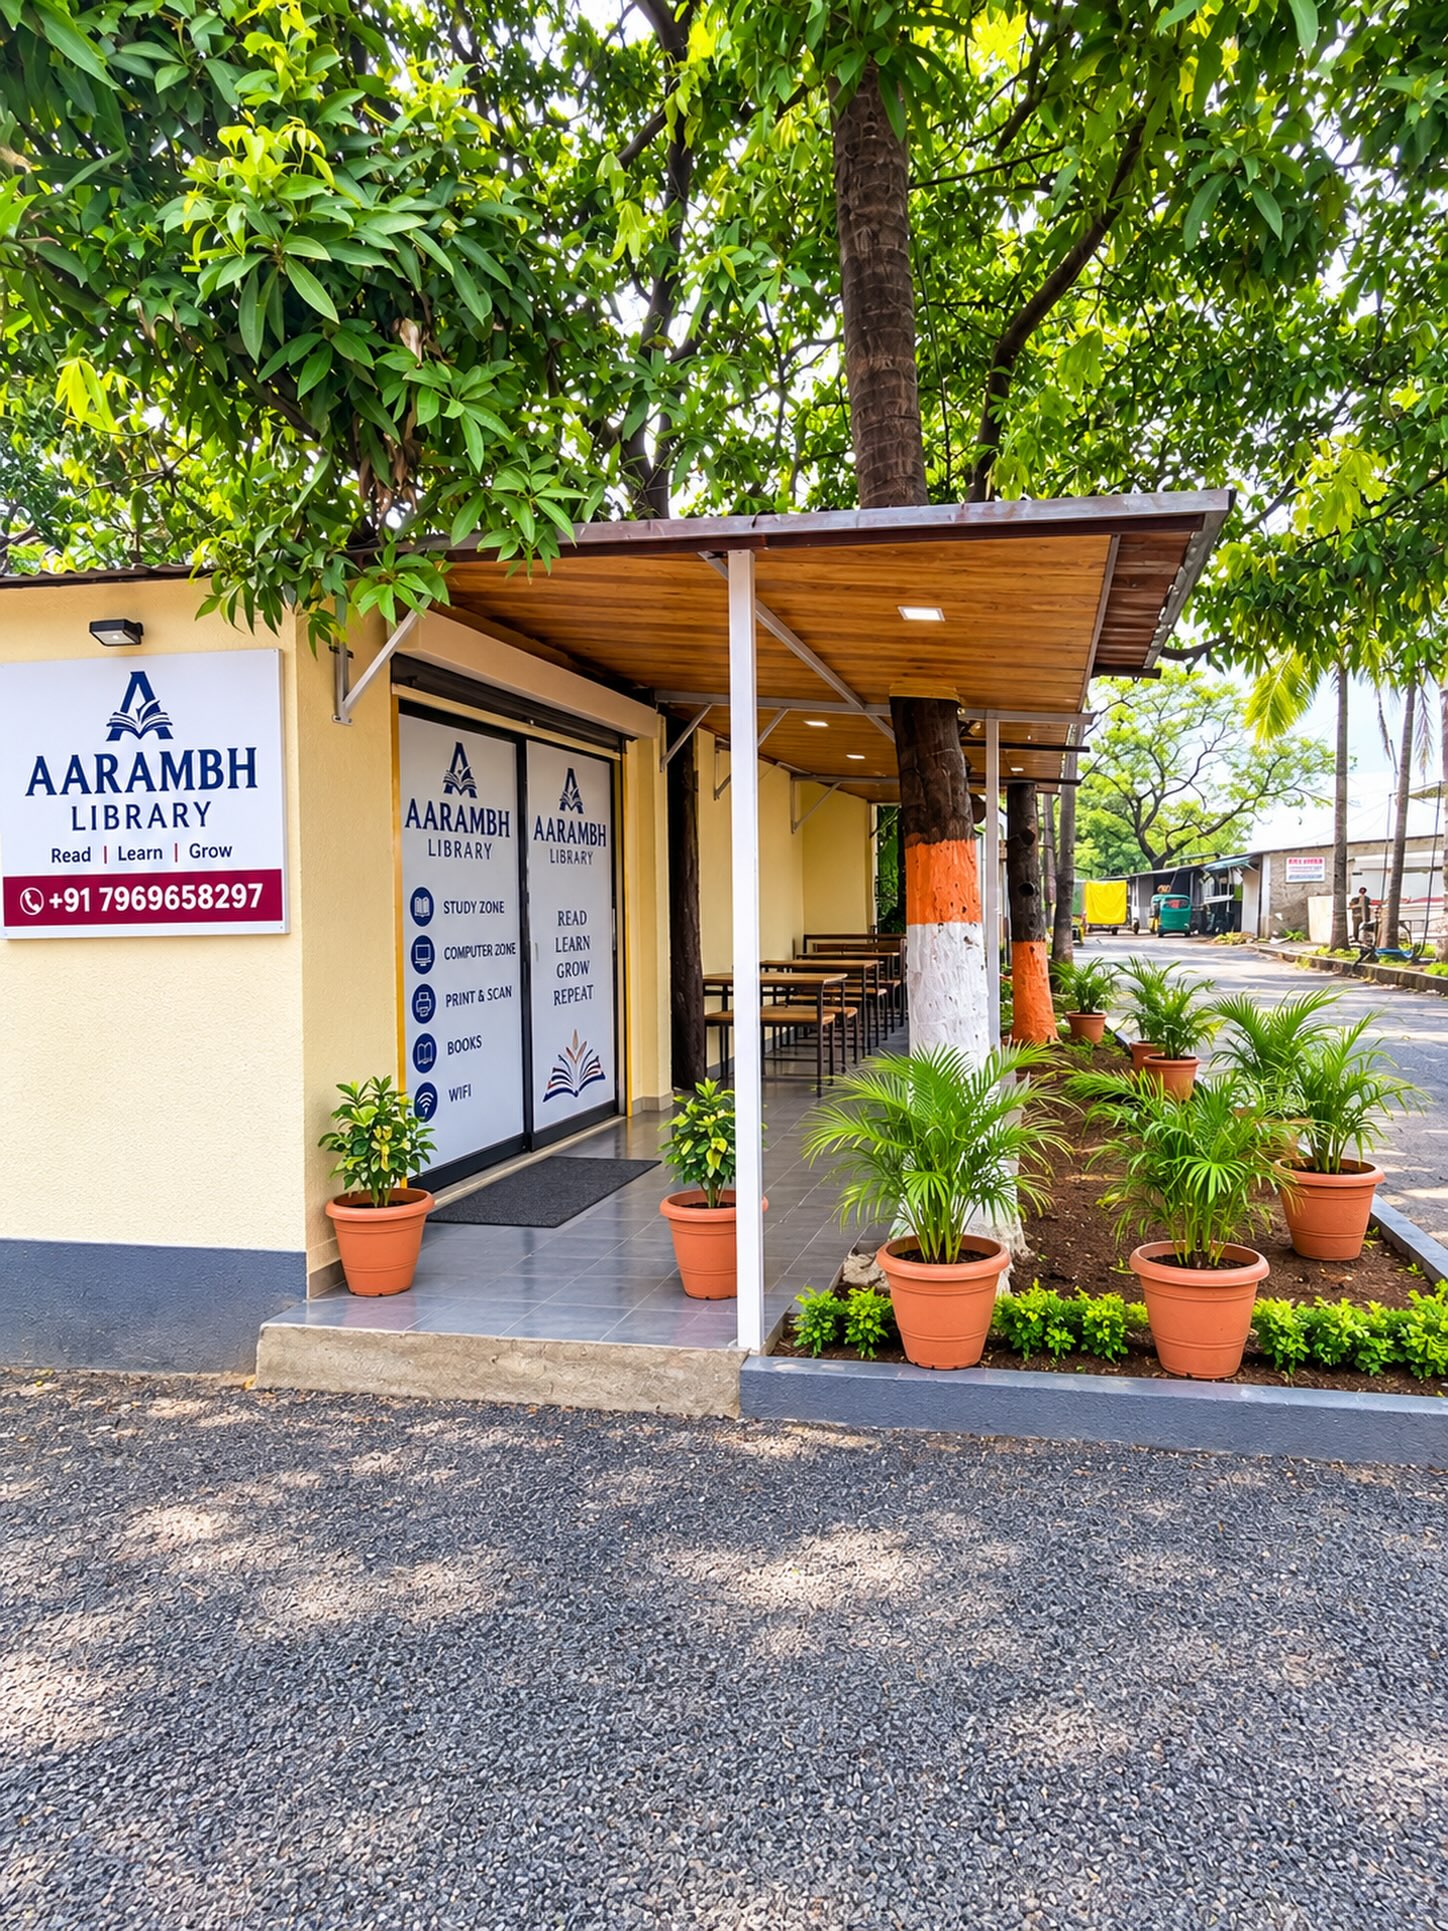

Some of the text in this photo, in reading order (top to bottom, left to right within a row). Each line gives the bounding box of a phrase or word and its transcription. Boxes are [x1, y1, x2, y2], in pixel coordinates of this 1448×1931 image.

[25, 747, 258, 796] AARAMBH
[72, 801, 211, 831] LIBRARY
[405, 798, 510, 838] AARAMBH
[534, 816, 606, 847] AARAMBH
[51, 843, 232, 863] Read Learn Grow
[428, 839, 492, 860] LIBRARY
[550, 849, 593, 865] LIBRARY
[49, 883, 263, 913] +91 7969658297
[443, 901, 504, 914] STUDY ZONE
[557, 910, 587, 926] READ
[444, 944, 493, 960] COMPUTER
[556, 936, 590, 953] LEARN
[557, 961, 590, 978] GROW
[446, 986, 512, 1007] PRINT & SCAN
[554, 985, 594, 1006] REPEAT
[448, 1035, 482, 1055] BOOKS
[449, 1084, 472, 1102] WIFI
